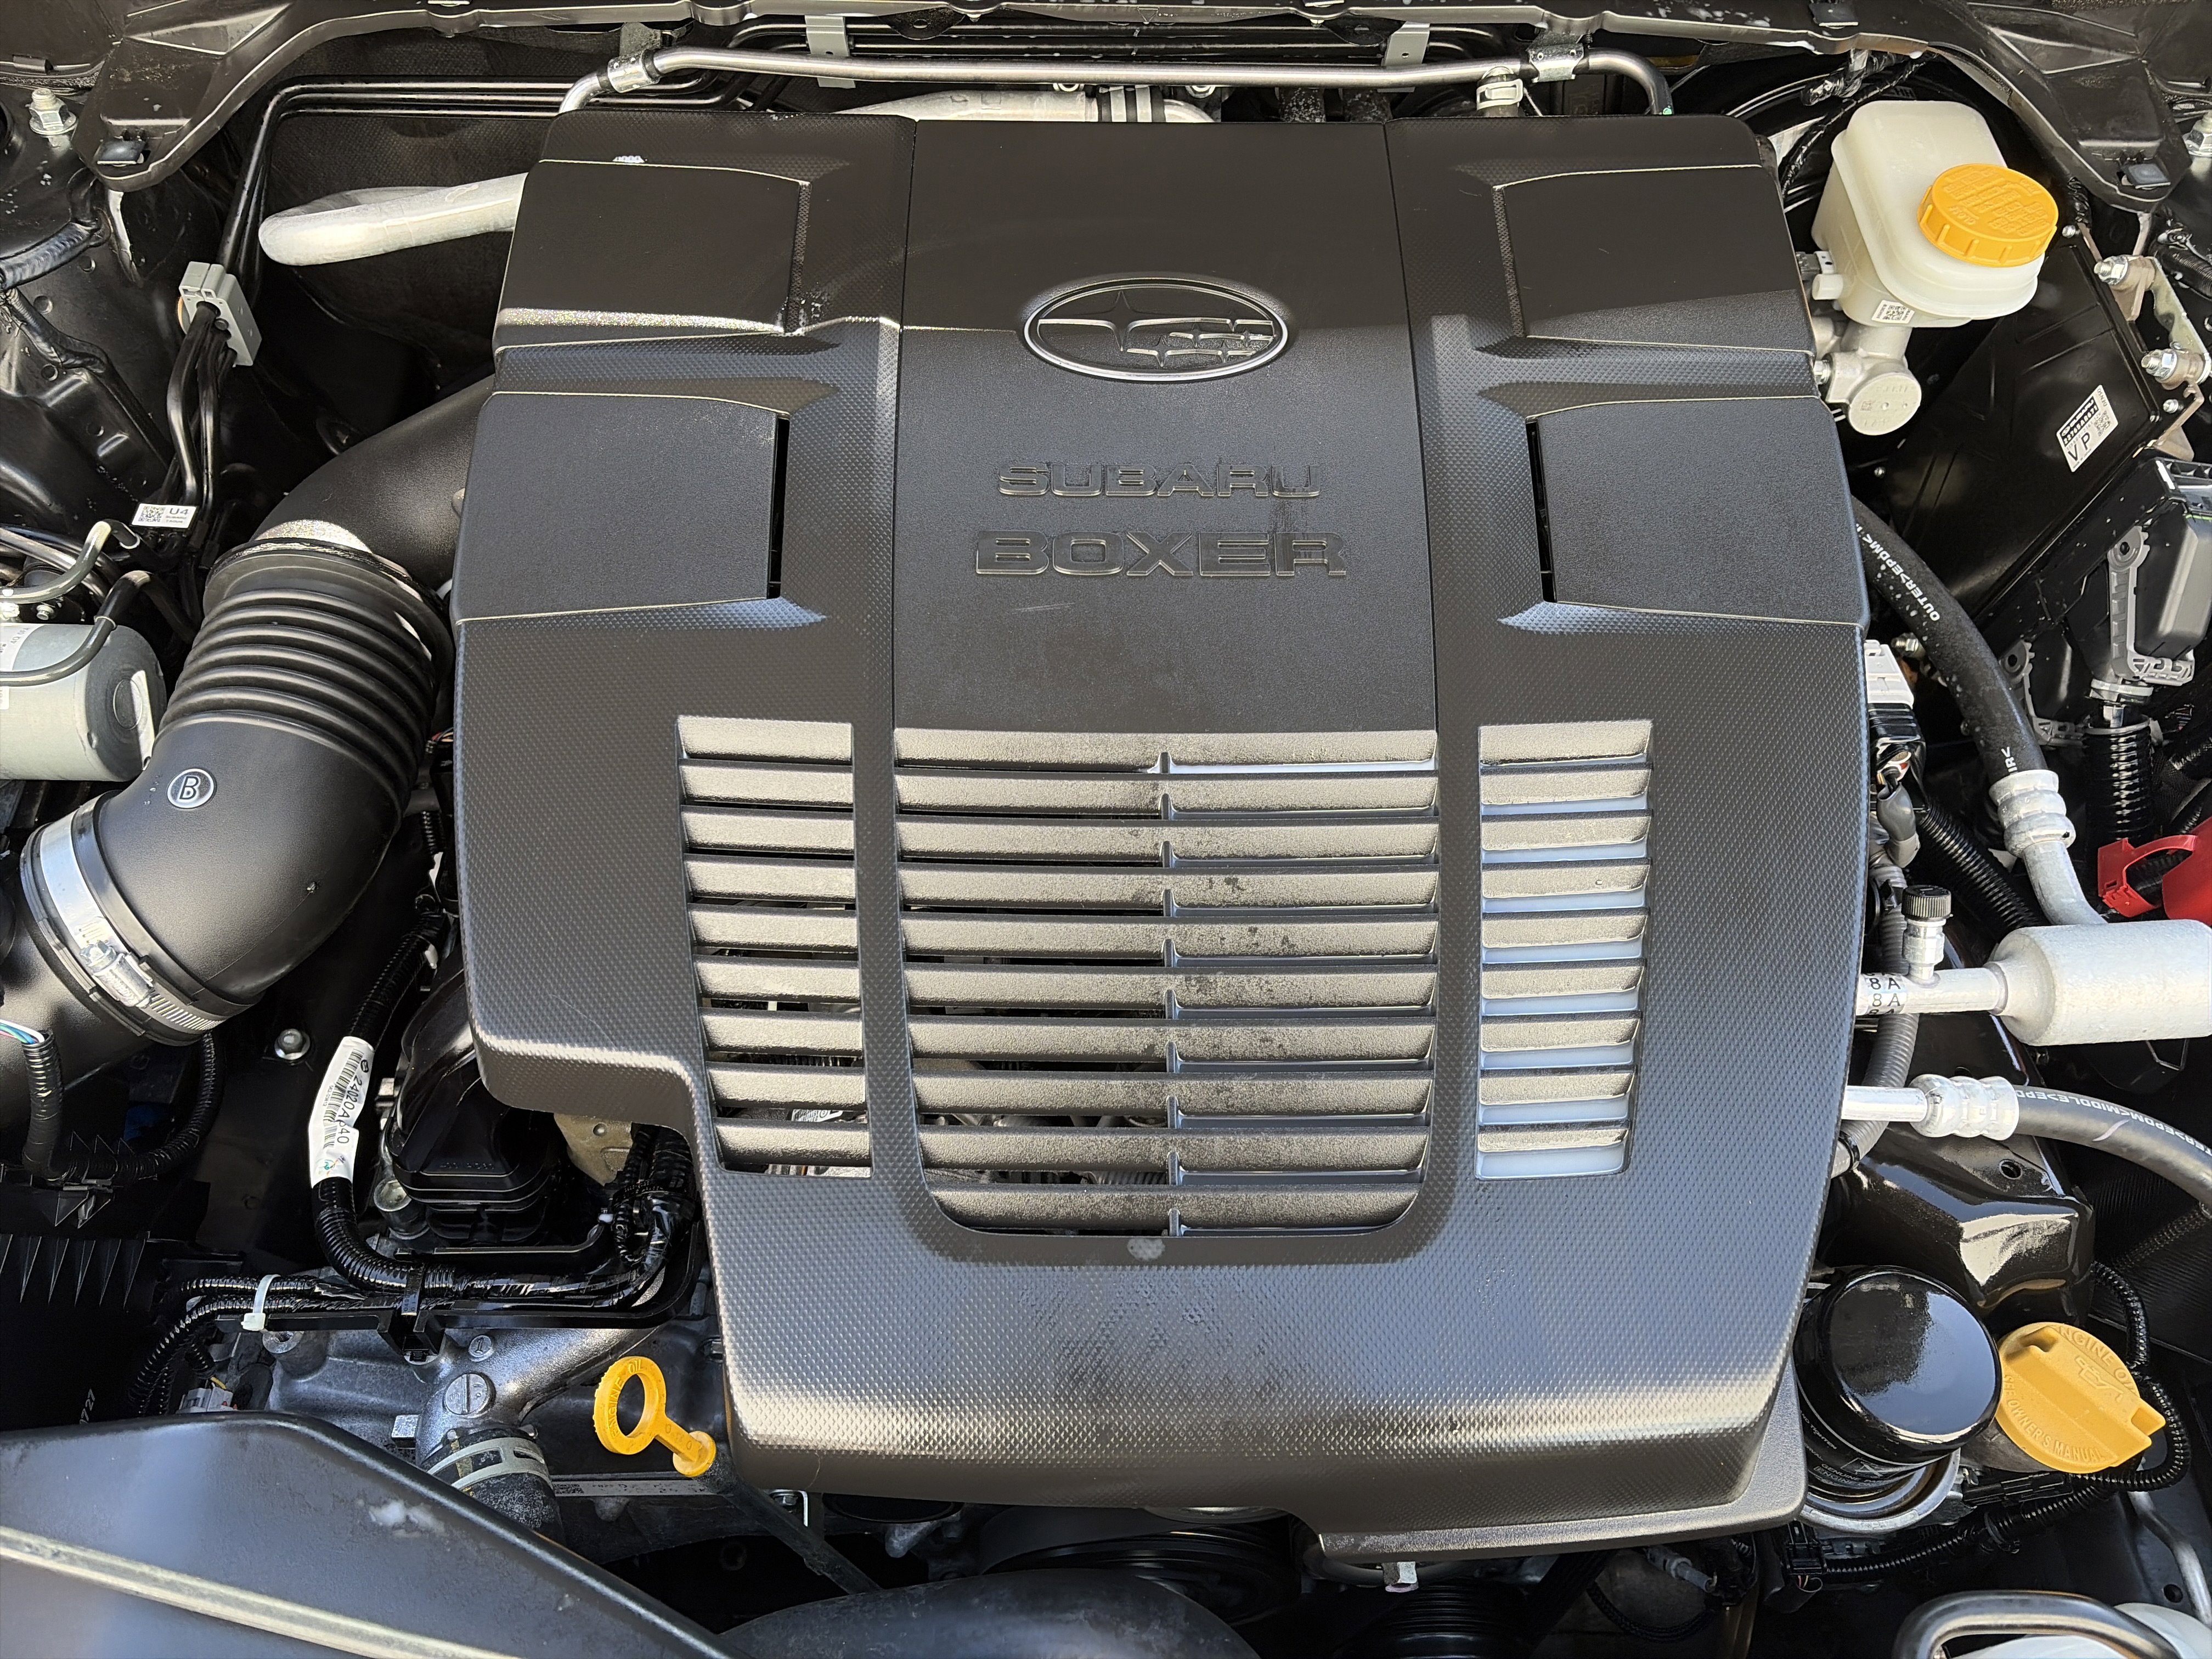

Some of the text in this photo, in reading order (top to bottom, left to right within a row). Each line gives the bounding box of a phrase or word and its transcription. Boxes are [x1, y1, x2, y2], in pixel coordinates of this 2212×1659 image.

[997, 463, 1322, 498] SUBARU
[170, 507, 189, 516] U4
[976, 531, 1347, 577] BOXER
[179, 776, 199, 800] B
[1869, 978, 1901, 990] 8 A
[1872, 993, 1900, 1007] 8 A
[2059, 1326, 2113, 1366] NGINE
[628, 1359, 644, 1374] OIL
[2004, 1374, 2104, 1462] SEE OWNER'S MANUAL
